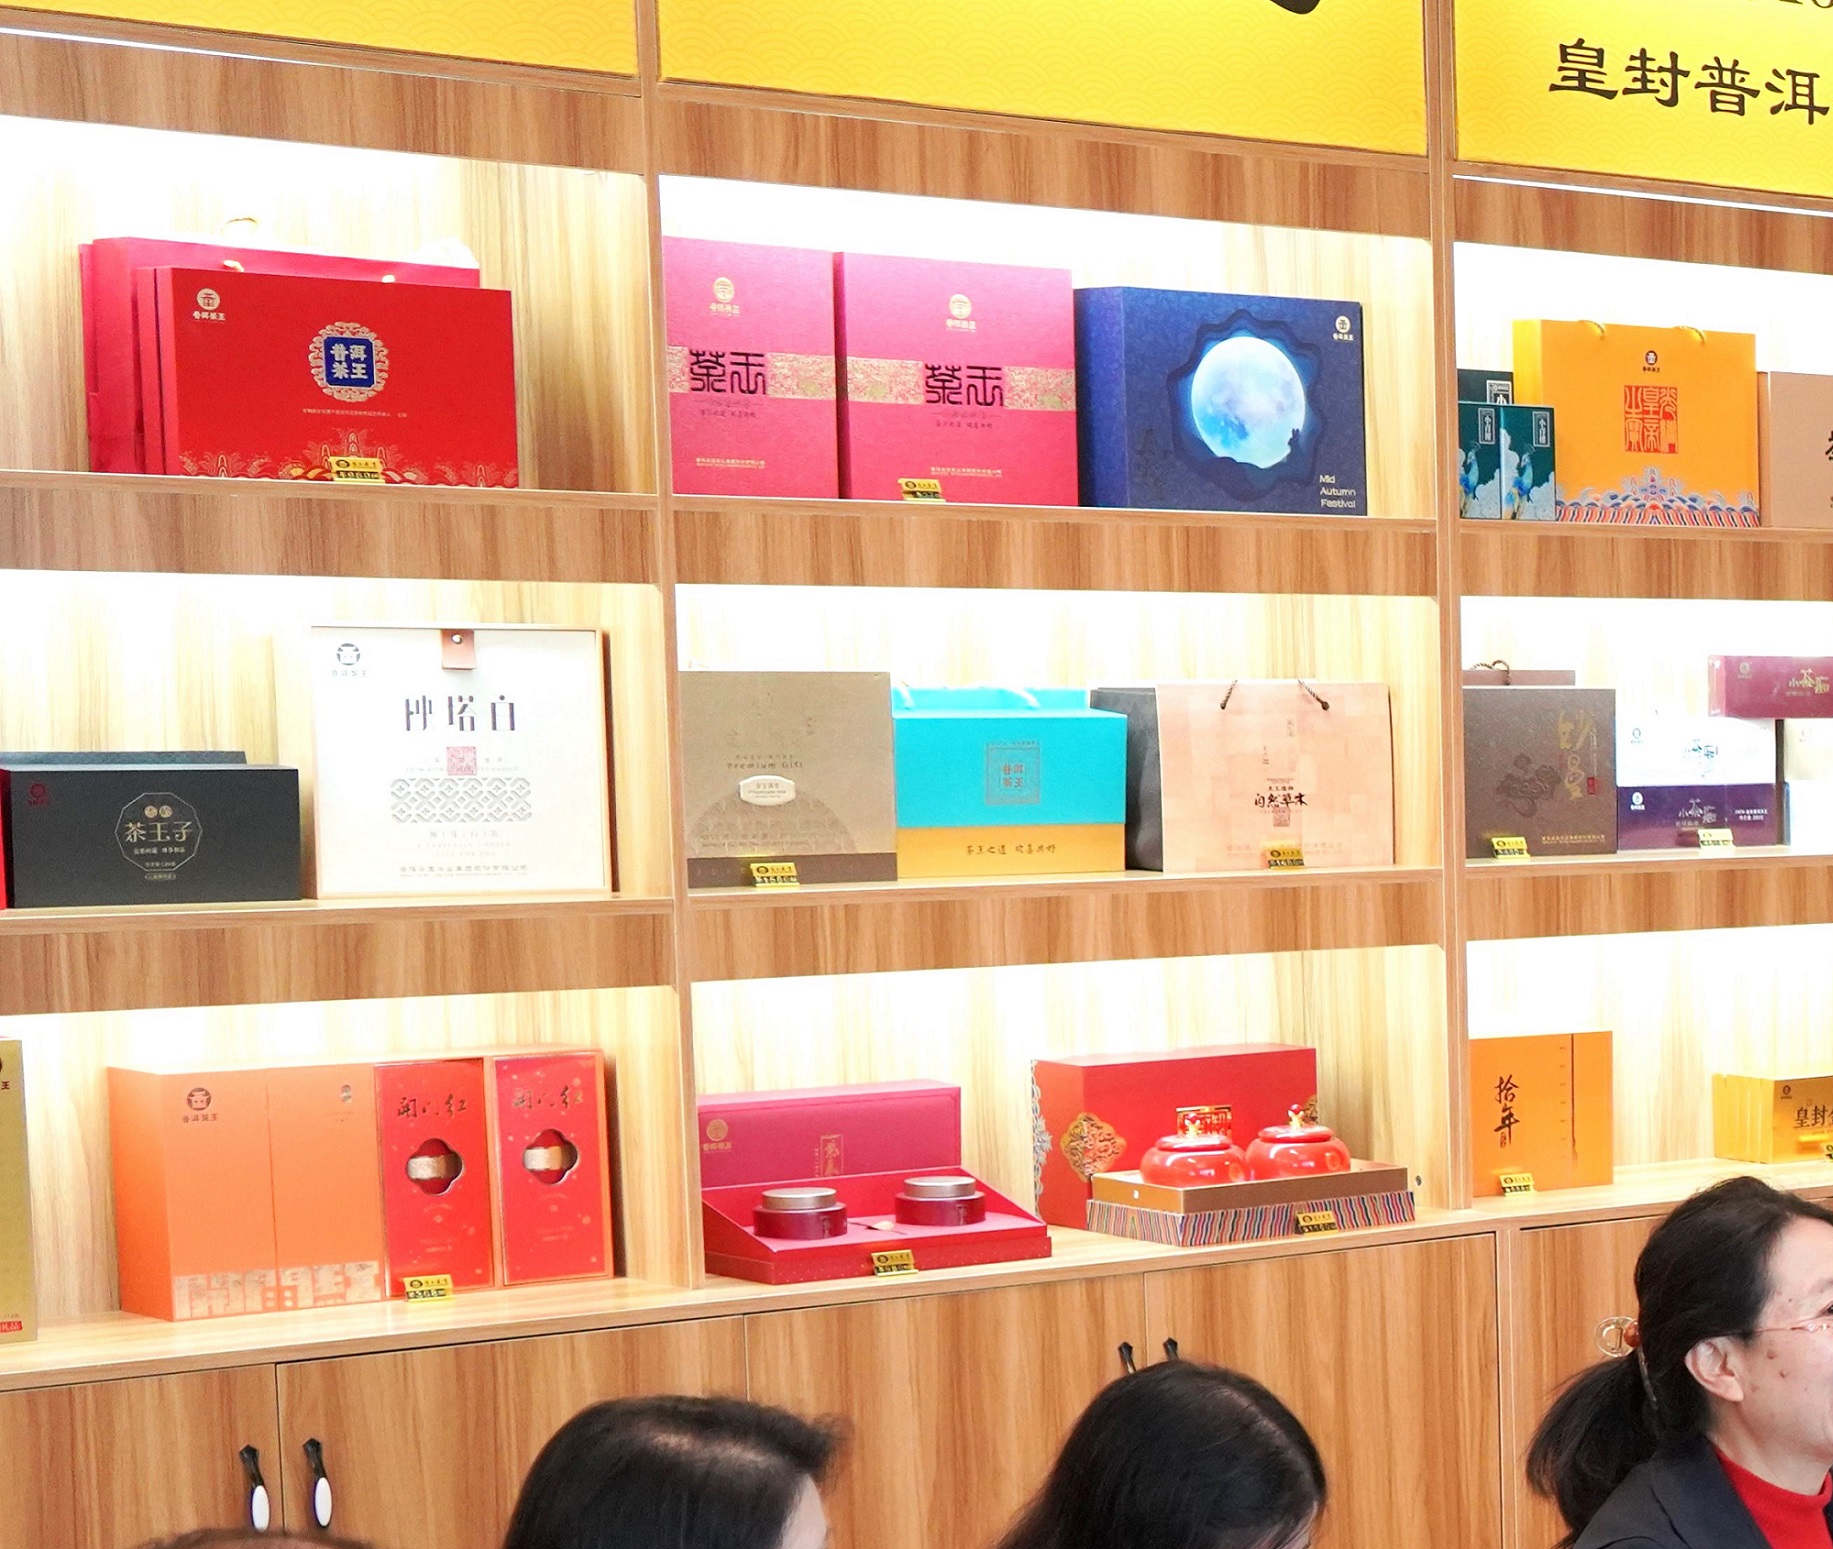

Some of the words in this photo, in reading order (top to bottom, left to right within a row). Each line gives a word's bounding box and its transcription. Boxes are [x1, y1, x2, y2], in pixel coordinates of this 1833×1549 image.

[330, 343, 367, 361] 普洱
[332, 361, 368, 379] 茶王
[1320, 486, 1356, 497] Autumn
[1321, 499, 1356, 509] Festival
[124, 820, 193, 844] 茶王子
[1494, 1074, 1521, 1146] 拾年
